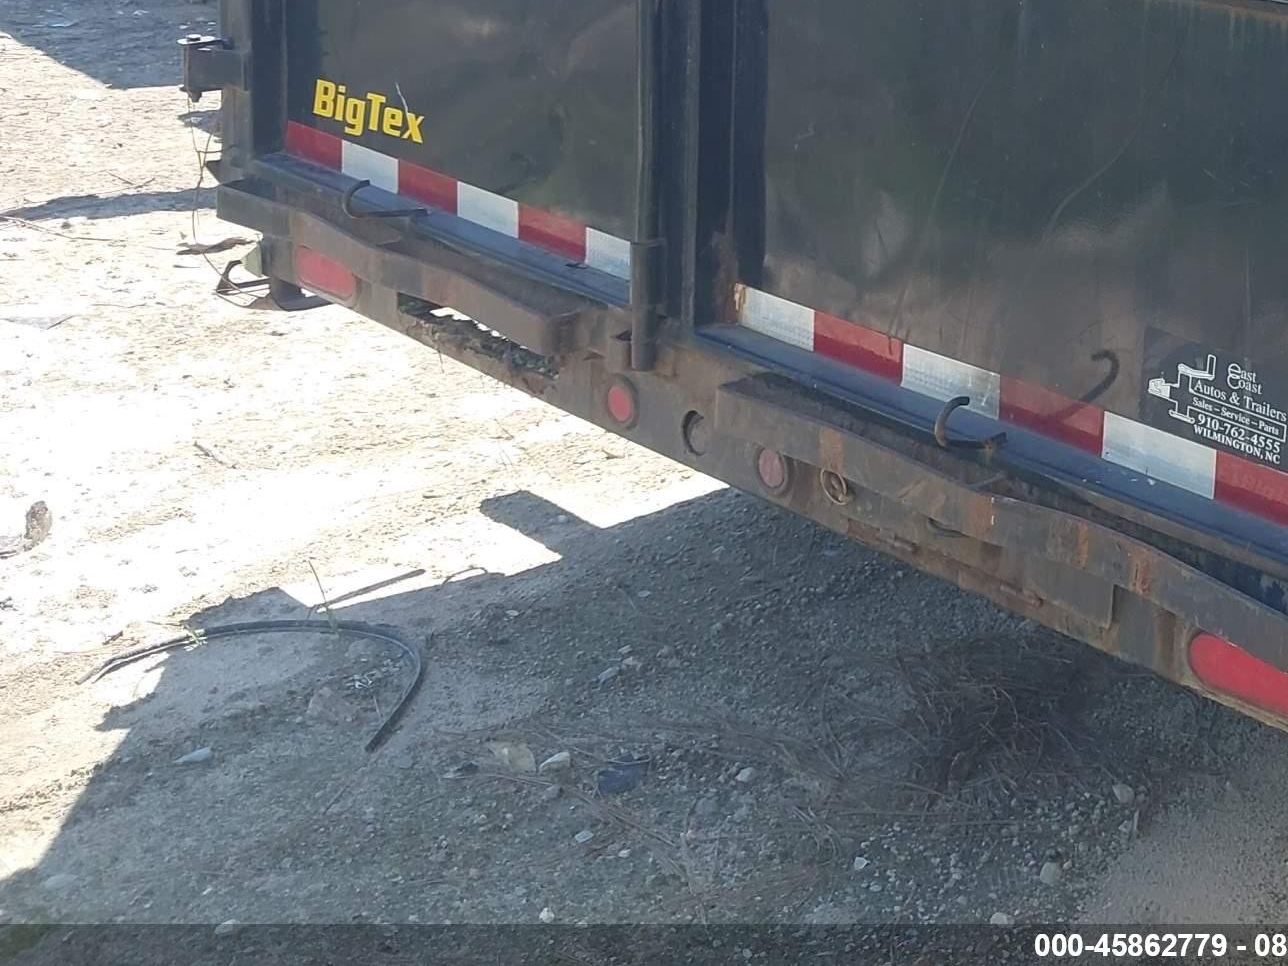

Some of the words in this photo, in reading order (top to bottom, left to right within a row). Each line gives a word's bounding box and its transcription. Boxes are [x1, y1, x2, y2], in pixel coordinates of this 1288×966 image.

[312, 78, 425, 145] BigTex
[1192, 396, 1213, 412] Sales
[1220, 407, 1250, 425] Service
[1258, 420, 1280, 436] Parts
[1194, 380, 1227, 401] Autos
[1229, 392, 1240, 406] &
[1243, 395, 1287, 422] Trailers
[1193, 424, 1264, 460] WILMINGTON,
[1264, 452, 1281, 465] NC
[1197, 414, 1281, 454] 910-762-4555
